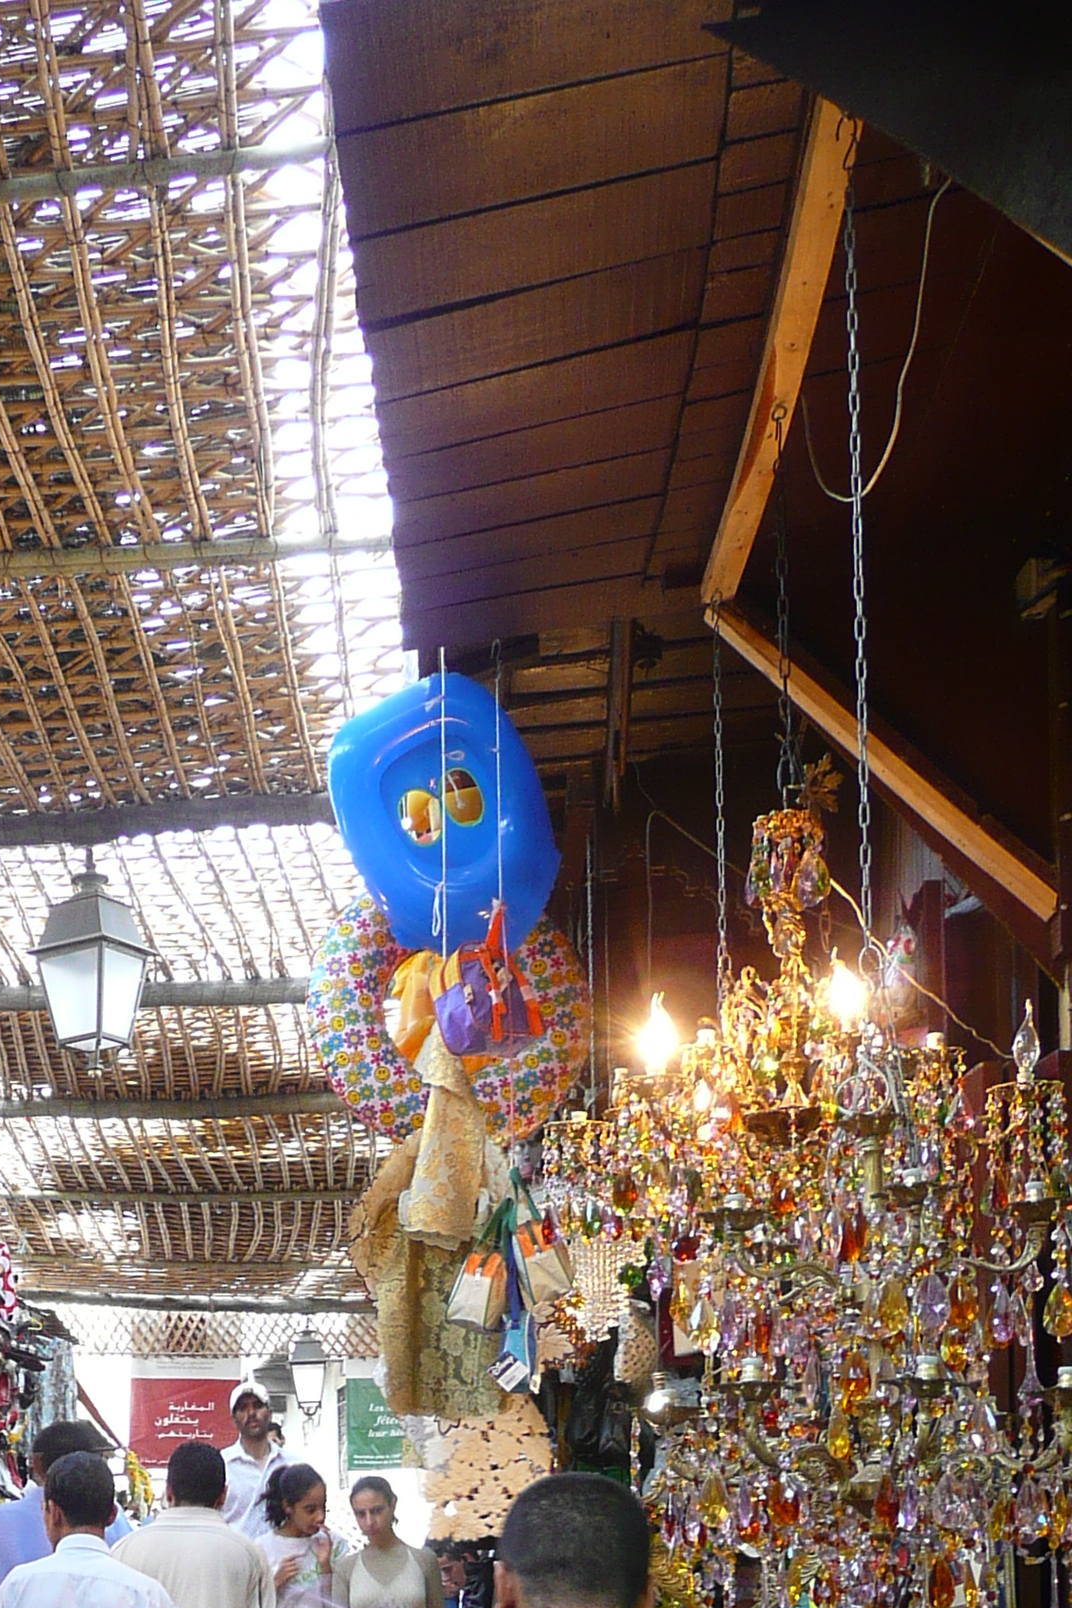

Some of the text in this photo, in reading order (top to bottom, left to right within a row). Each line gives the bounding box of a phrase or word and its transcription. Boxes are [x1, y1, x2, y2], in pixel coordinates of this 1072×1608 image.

[486, 1355, 515, 1376] Disney
[168, 1401, 214, 1412] المغاربة
[368, 1403, 385, 1412] Les
[368, 1428, 389, 1438] leur
